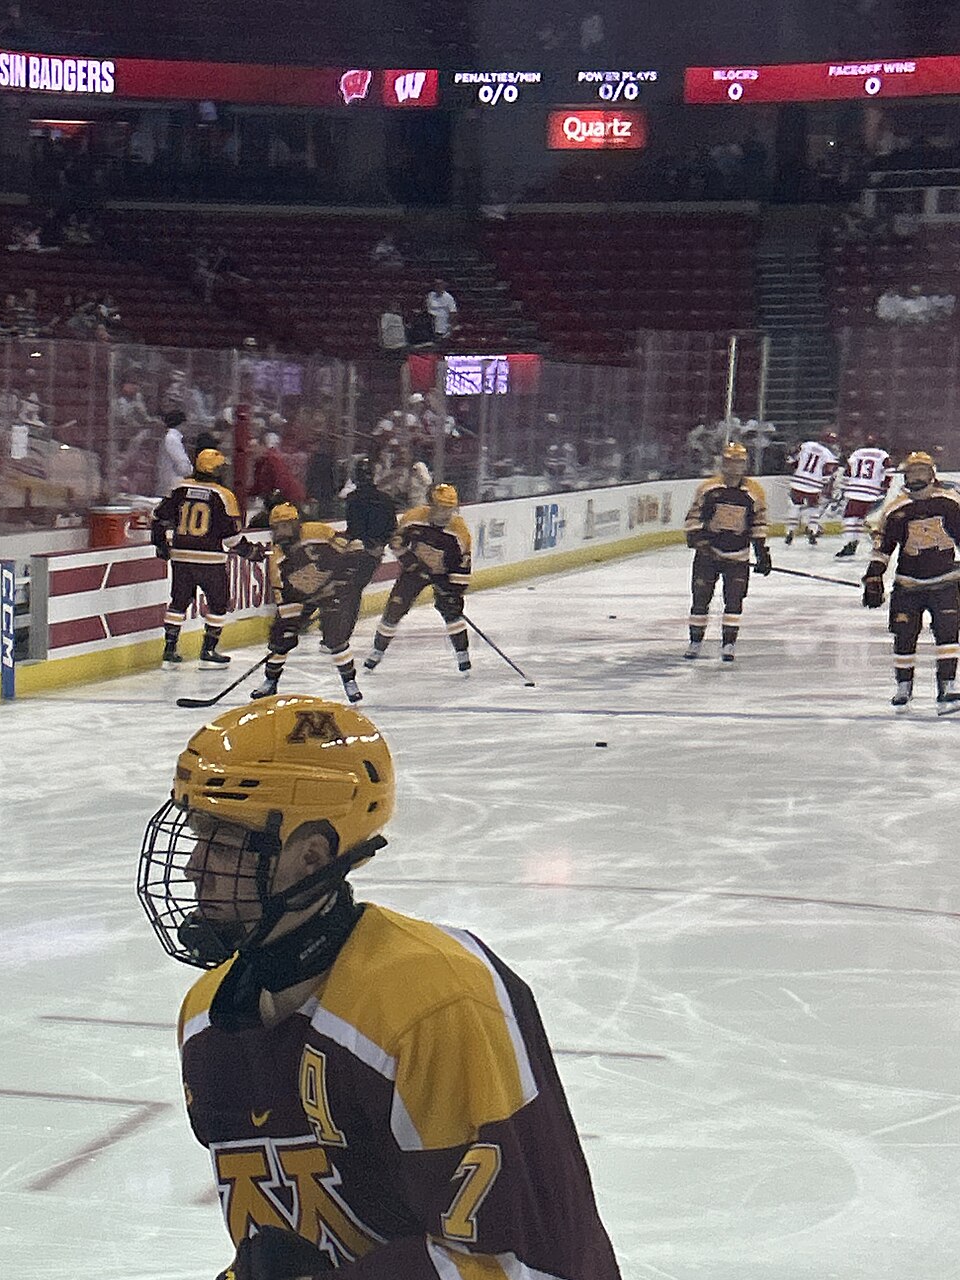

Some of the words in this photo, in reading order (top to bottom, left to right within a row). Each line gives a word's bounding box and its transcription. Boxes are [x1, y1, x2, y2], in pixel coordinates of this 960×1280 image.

[29, 57, 115, 93] BADGERS
[578, 71, 620, 82] POWER
[622, 71, 658, 81] PLAYS
[829, 63, 882, 76] FACEOFF
[884, 62, 916, 74] WINS
[478, 85, 519, 105] 0/0
[599, 82, 640, 101] 0/0
[727, 83, 744, 101] 0
[864, 77, 882, 95] 0
[563, 116, 633, 142] Quartz
[803, 453, 820, 473] 11
[857, 459, 875, 480] 13
[177, 501, 212, 537] 10
[298, 1043, 348, 1147] A
[441, 1143, 501, 1242] 7
